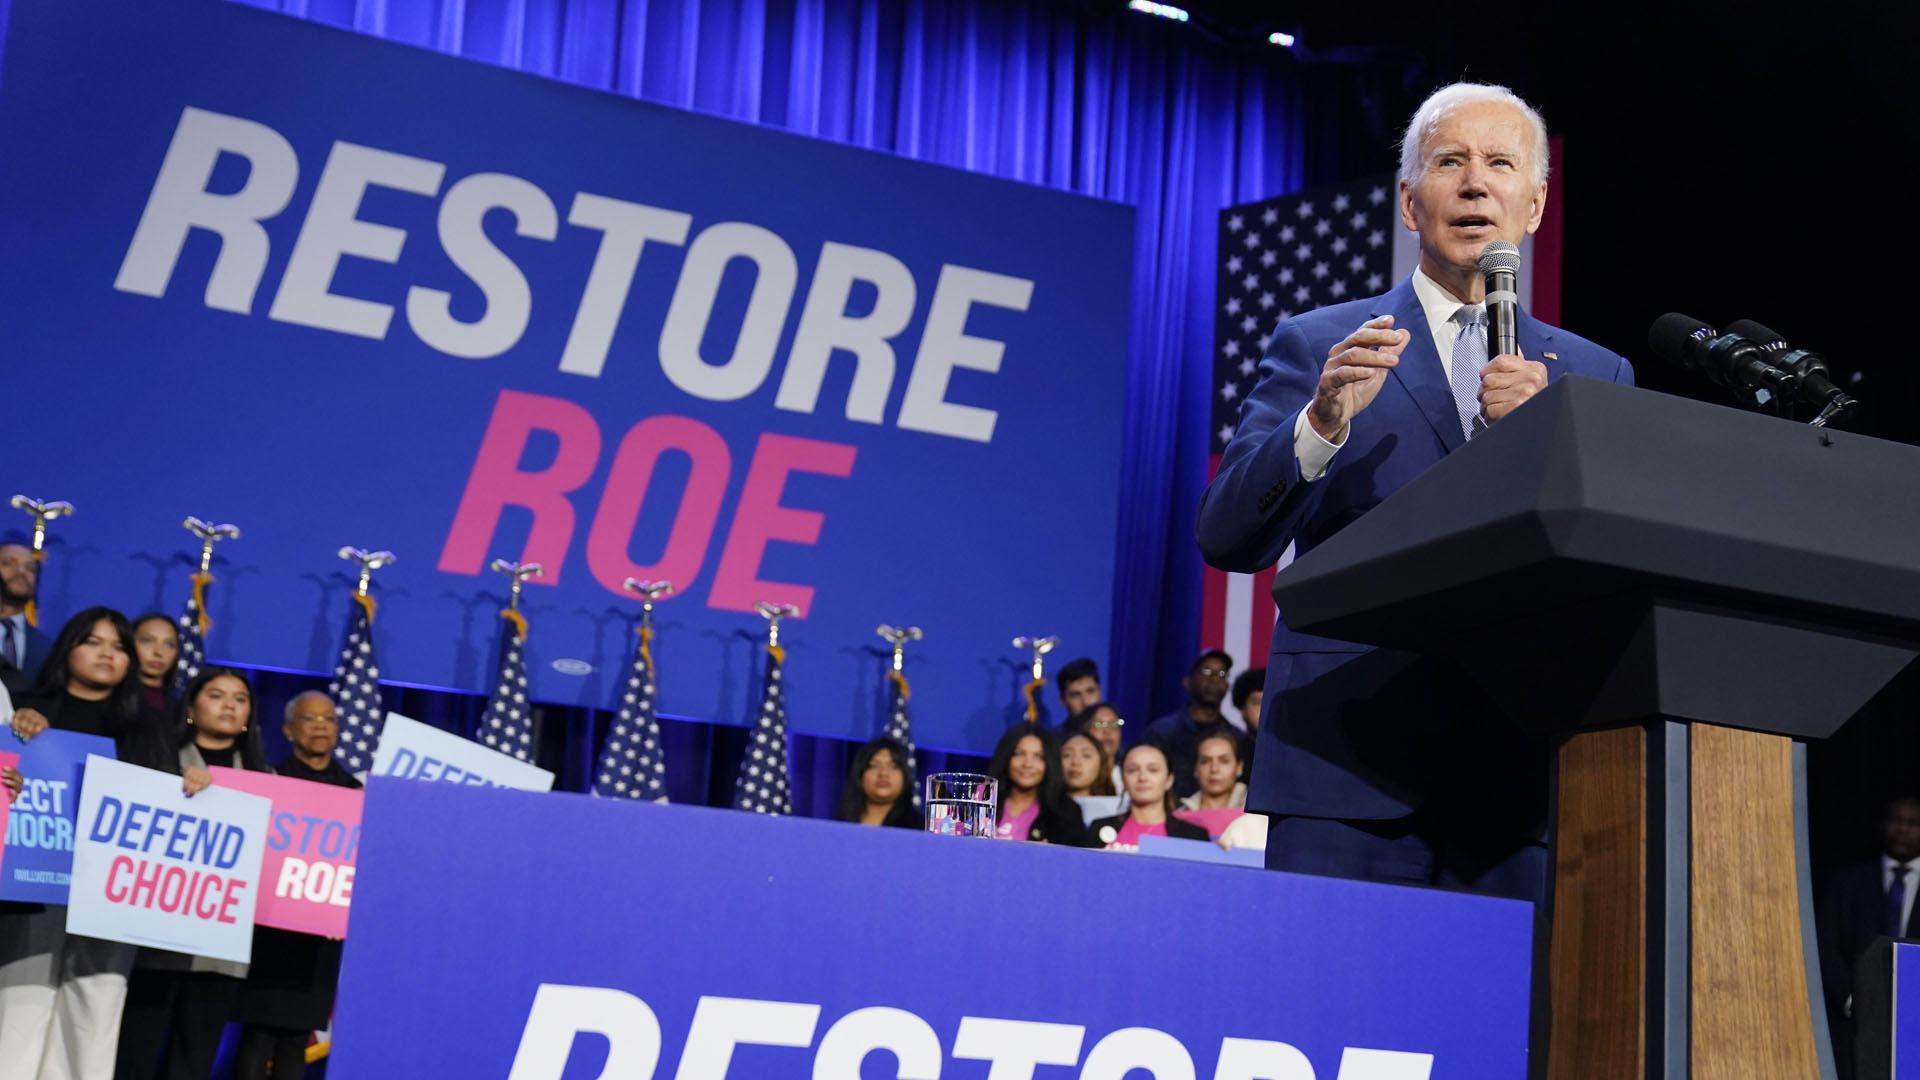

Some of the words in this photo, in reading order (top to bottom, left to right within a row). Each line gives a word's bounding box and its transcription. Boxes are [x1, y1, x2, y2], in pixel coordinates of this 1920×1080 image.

[114, 106, 1034, 443] RESTORE
[437, 390, 857, 618] ROE
[9, 777, 68, 815] ECT
[90, 796, 245, 869] DEFEND
[104, 856, 247, 924] CHOICE
[275, 857, 356, 907] ROE
